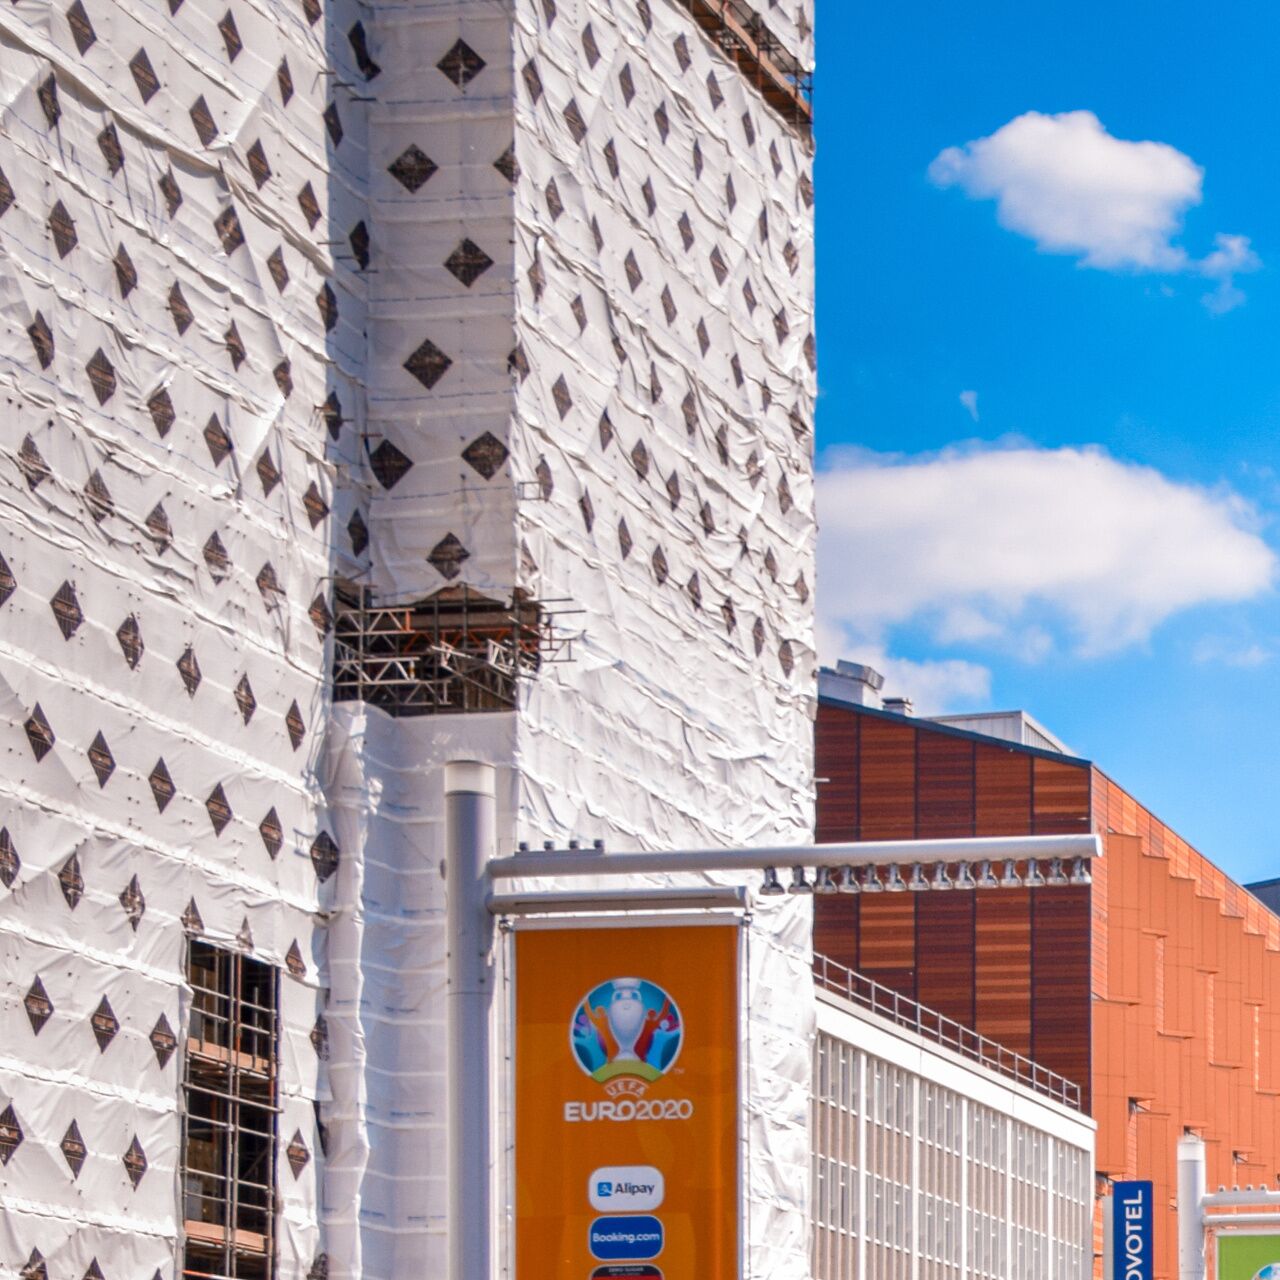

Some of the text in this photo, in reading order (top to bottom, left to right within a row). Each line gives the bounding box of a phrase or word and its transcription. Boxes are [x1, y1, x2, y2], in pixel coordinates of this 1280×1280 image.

[606, 1079, 648, 1098] UEFA
[564, 1100, 693, 1121] EURO2020
[615, 1181, 654, 1196] Alipay
[593, 1231, 660, 1244] Booking.com
